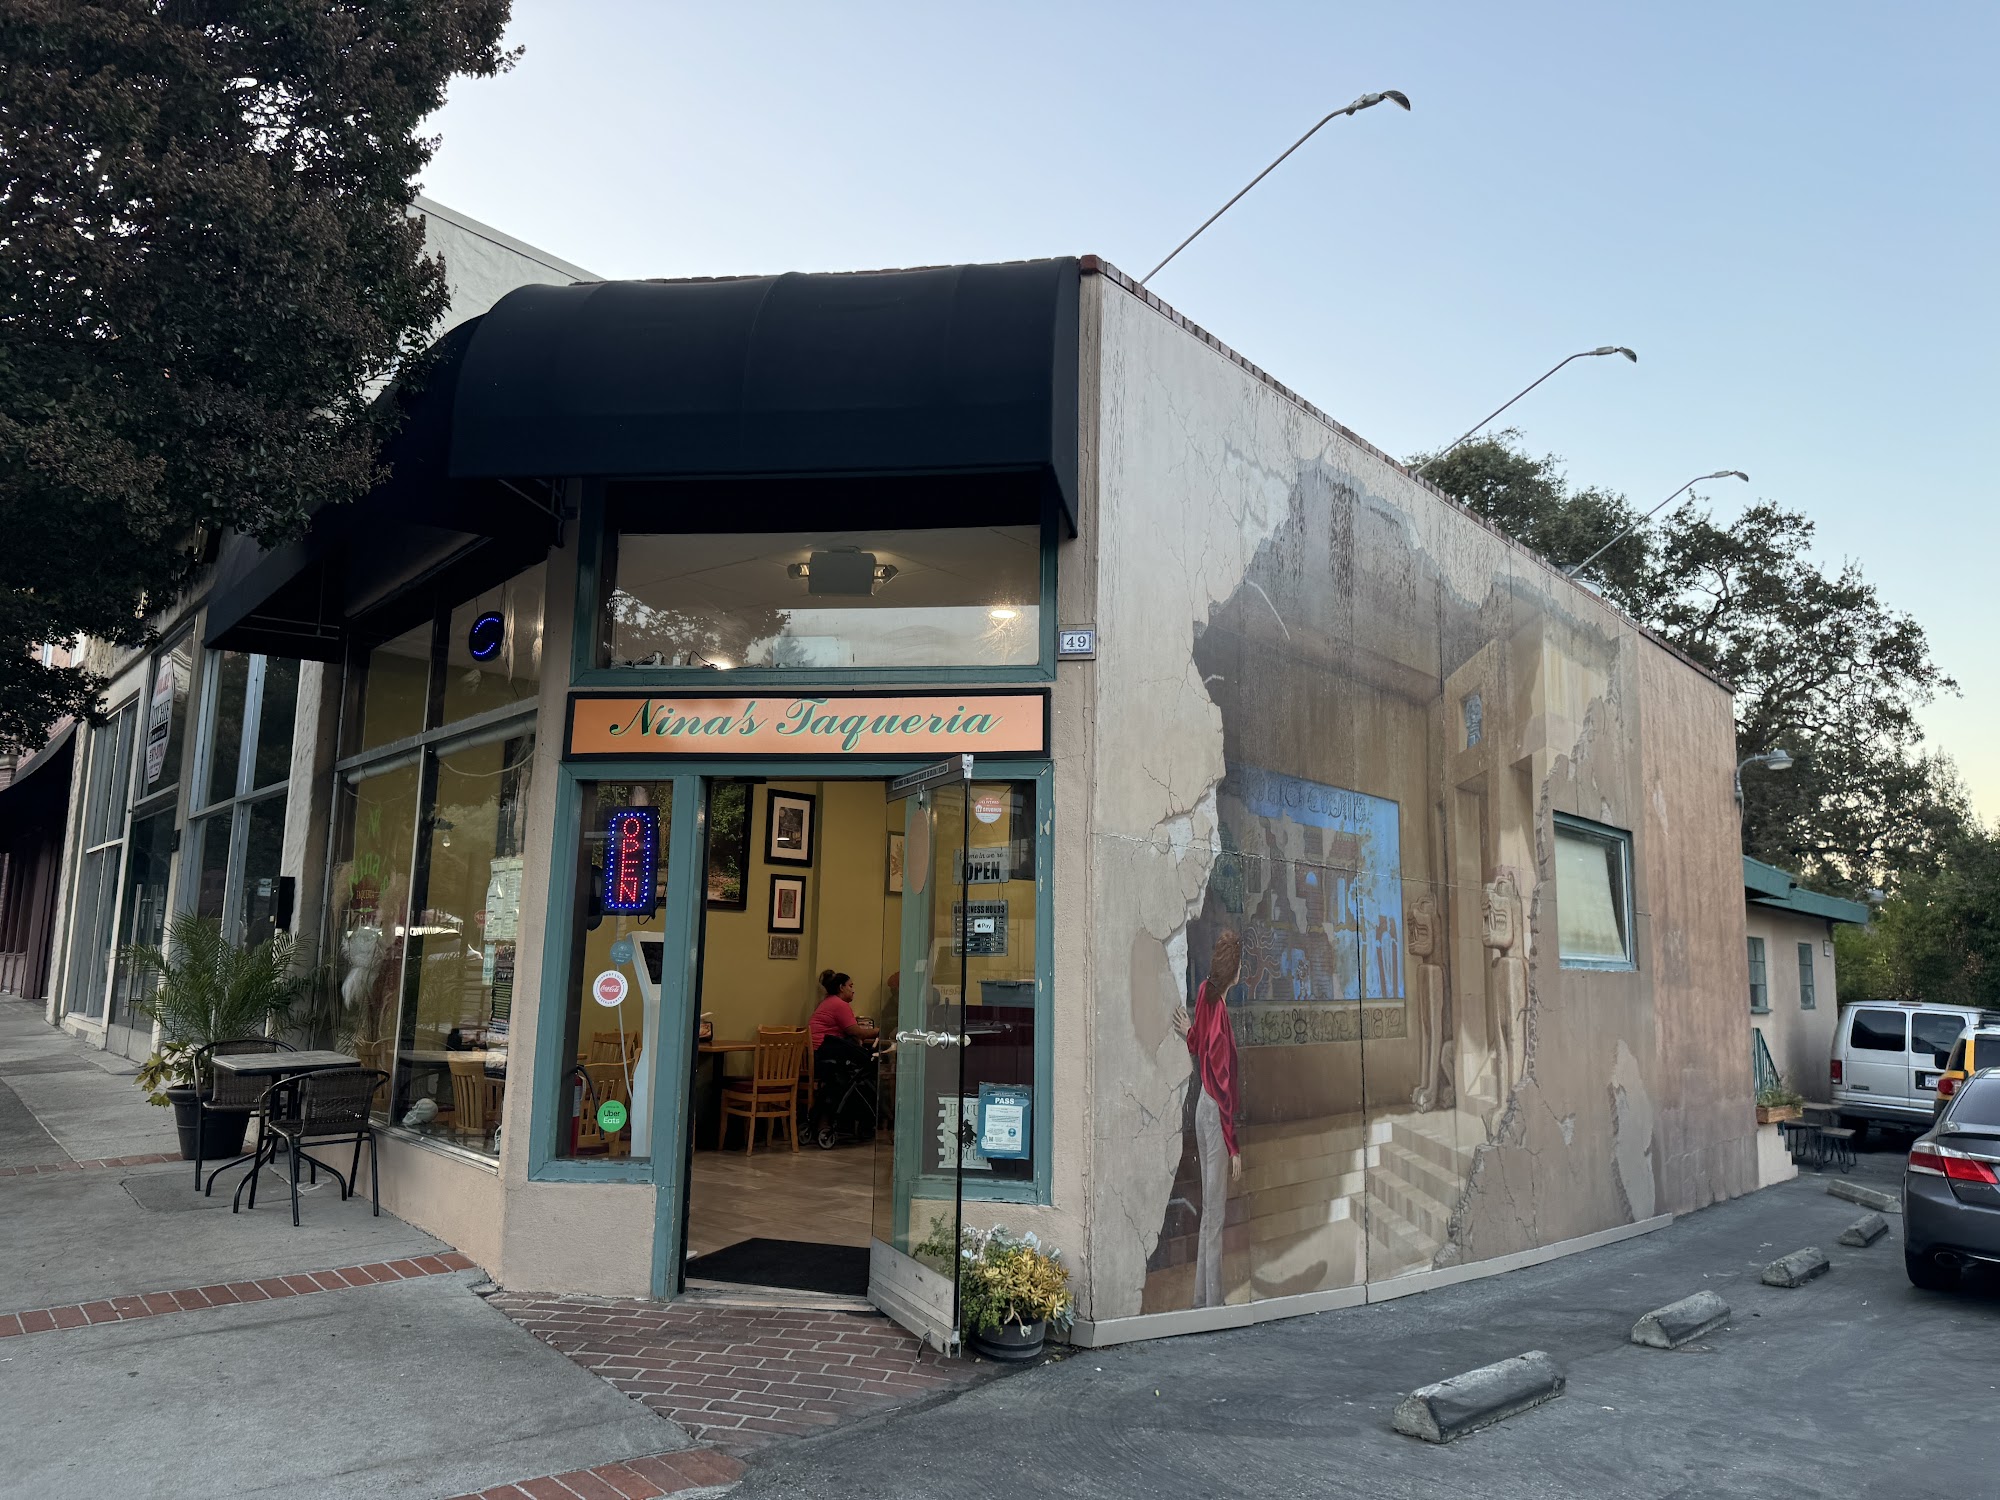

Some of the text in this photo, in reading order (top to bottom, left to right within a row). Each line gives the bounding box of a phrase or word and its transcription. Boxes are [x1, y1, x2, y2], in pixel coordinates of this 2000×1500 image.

[1066, 635, 1087, 648] 49
[610, 697, 1004, 752] Nina's Taqueria
[619, 818, 640, 902] OPEN
[962, 861, 1000, 880] OPEN
[954, 905, 985, 914] BUINESS
[994, 1097, 1015, 1105] PASS
